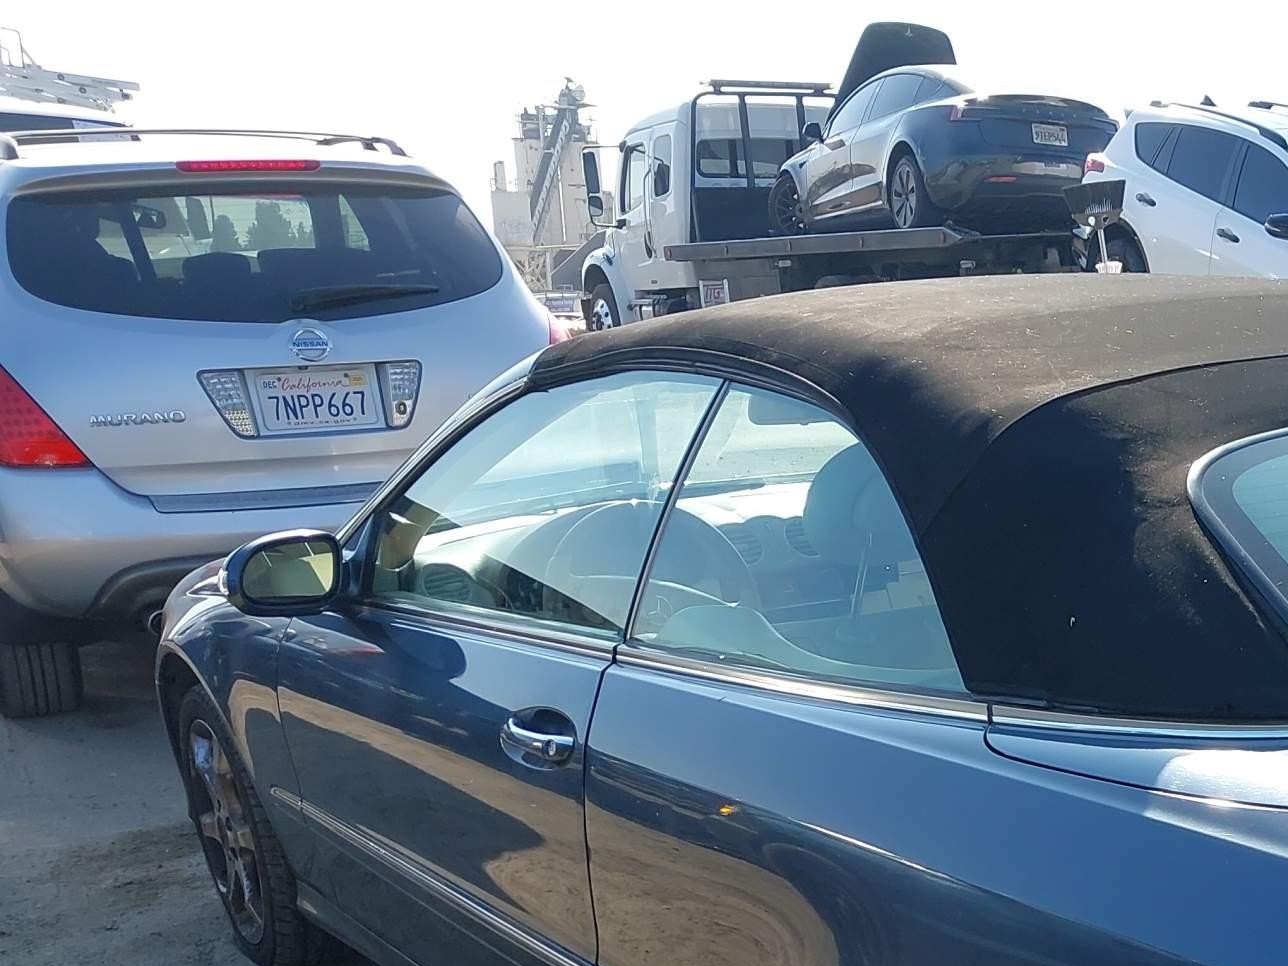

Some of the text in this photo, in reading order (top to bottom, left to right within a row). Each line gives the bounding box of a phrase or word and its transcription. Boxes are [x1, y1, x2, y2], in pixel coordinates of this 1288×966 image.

[292, 340, 329, 348] NISSAN
[262, 380, 278, 389] DEC
[281, 376, 344, 393] California
[267, 390, 366, 421] 7NPP667
[89, 410, 186, 428] MURANO
